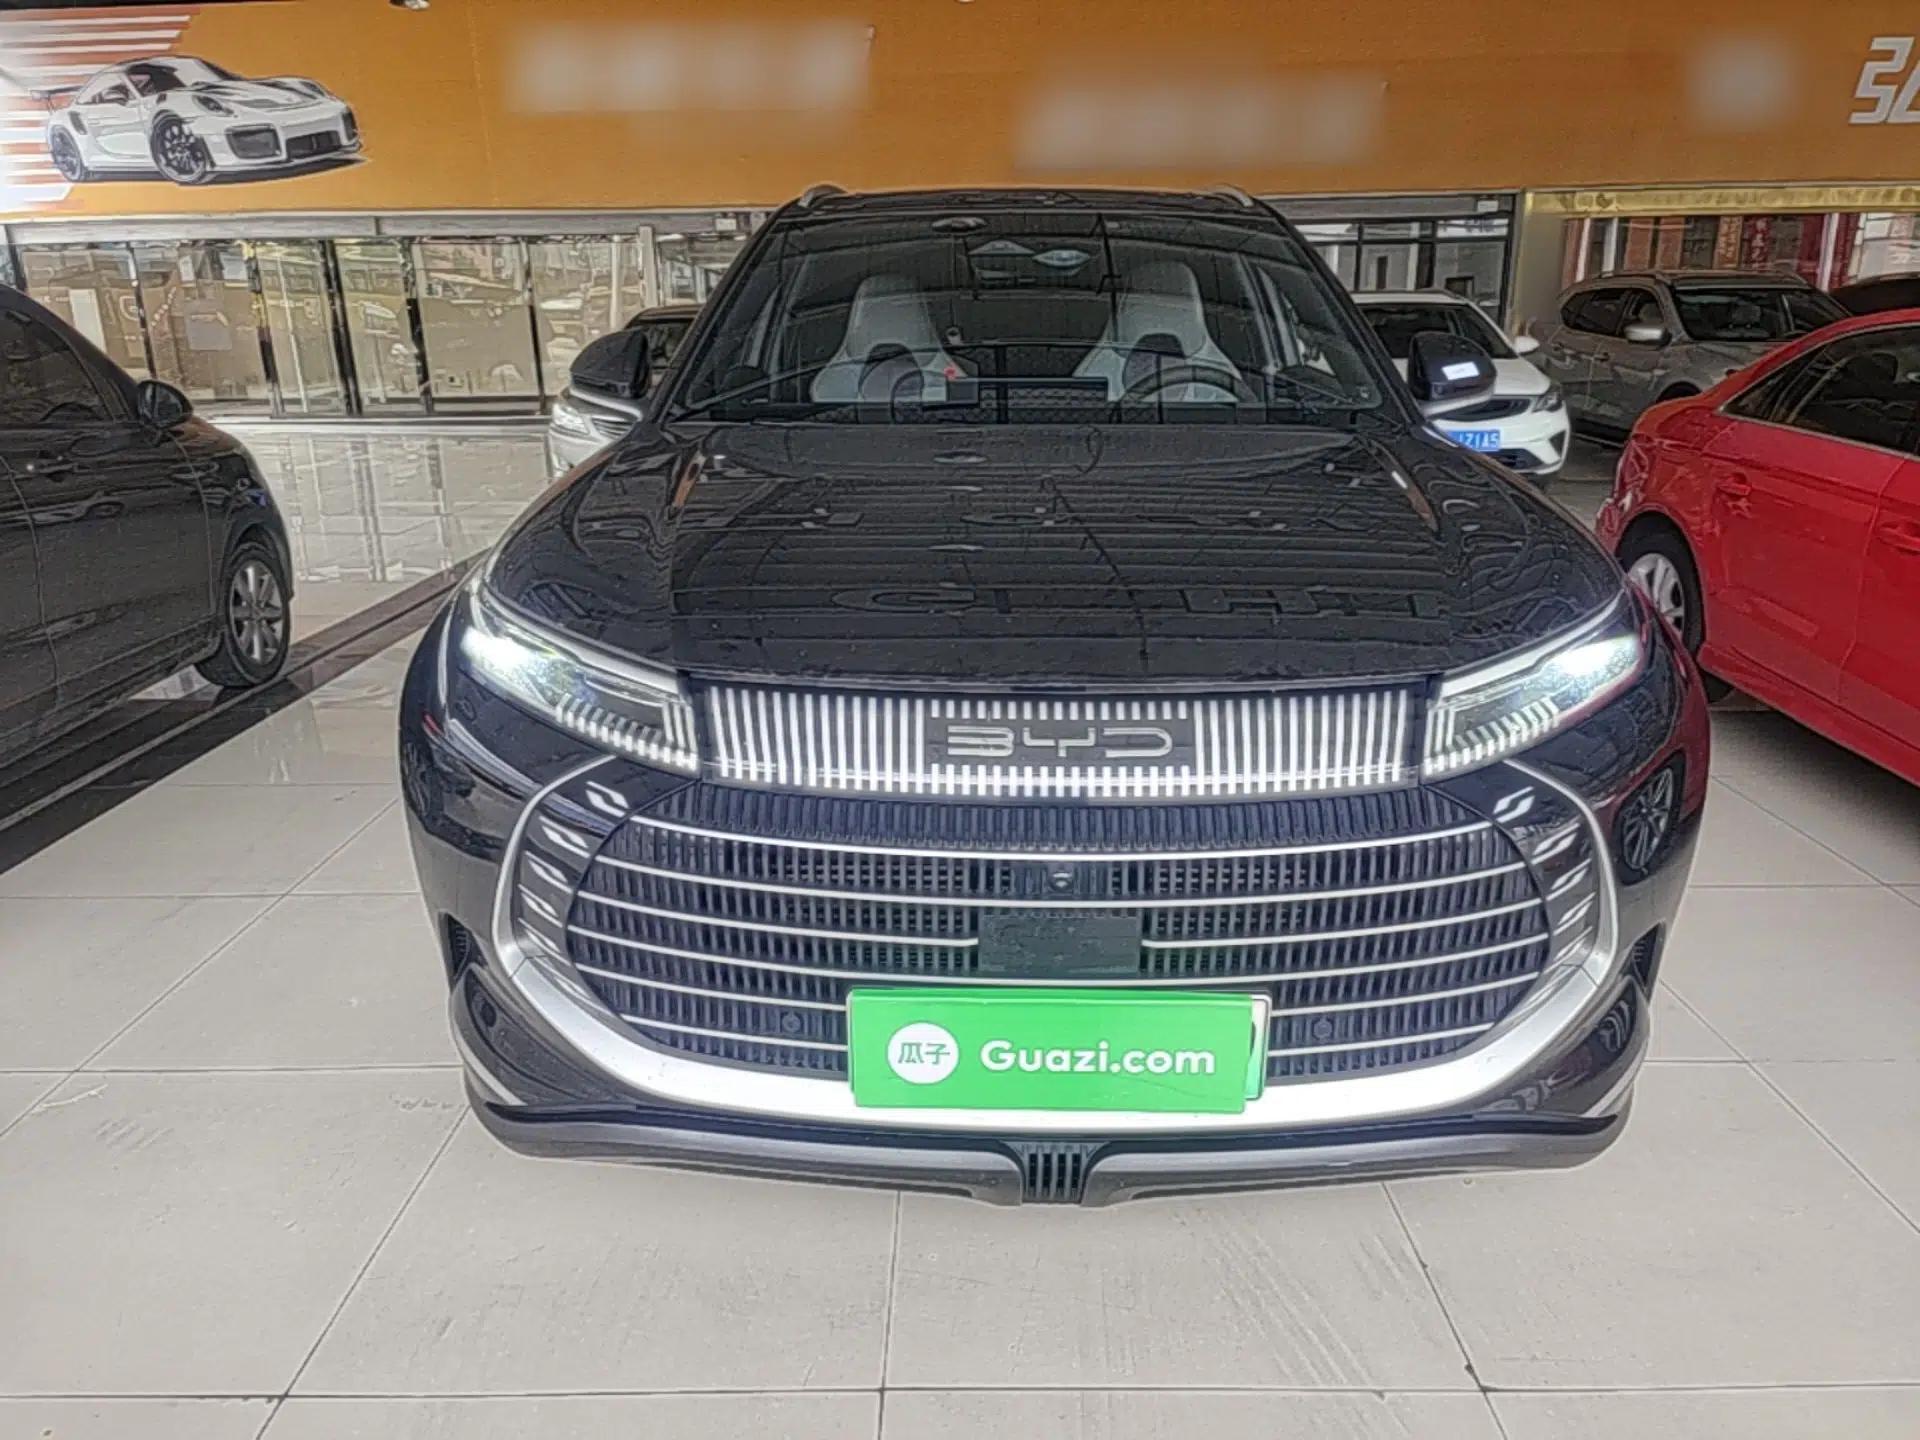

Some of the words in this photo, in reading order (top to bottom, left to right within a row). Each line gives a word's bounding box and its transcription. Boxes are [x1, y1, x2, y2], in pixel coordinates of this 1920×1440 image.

[947, 725, 1173, 758] BYD
[897, 1042, 951, 1066] 瓜子
[980, 1039, 1215, 1074] Guazi.com
